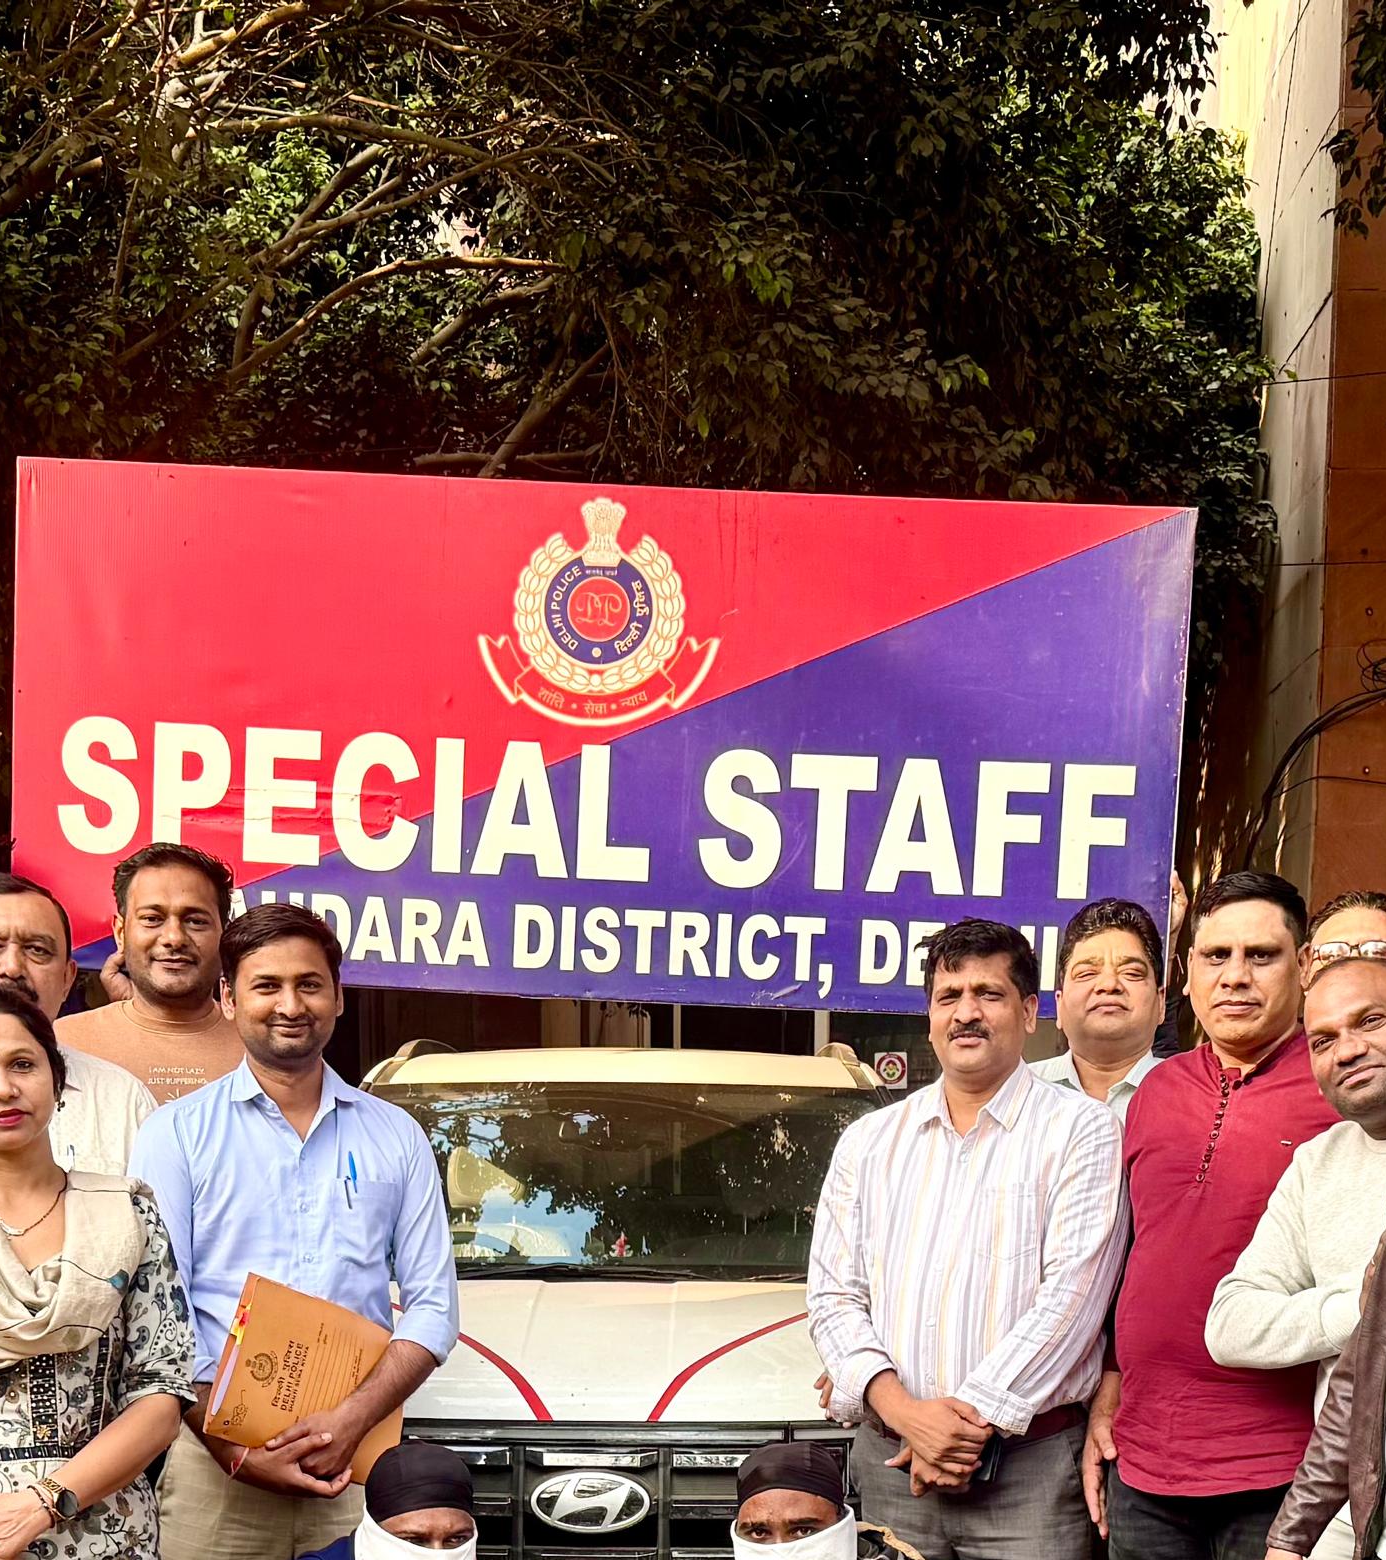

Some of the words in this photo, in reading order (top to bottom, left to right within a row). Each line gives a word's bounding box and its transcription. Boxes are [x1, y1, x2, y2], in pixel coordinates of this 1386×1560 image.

[551, 565, 582, 611] POLICE
[551, 614, 579, 651] DELHI
[537, 686, 566, 710] शांति
[583, 700, 607, 715] सेवा
[621, 690, 649, 708] न्याय
[57, 715, 650, 884] SPECIAL
[698, 748, 1137, 900] STAFF
[513, 903, 832, 998] DISTRICT,
[280, 1380, 294, 1411] DELHI
[289, 1343, 304, 1379] POLICE
